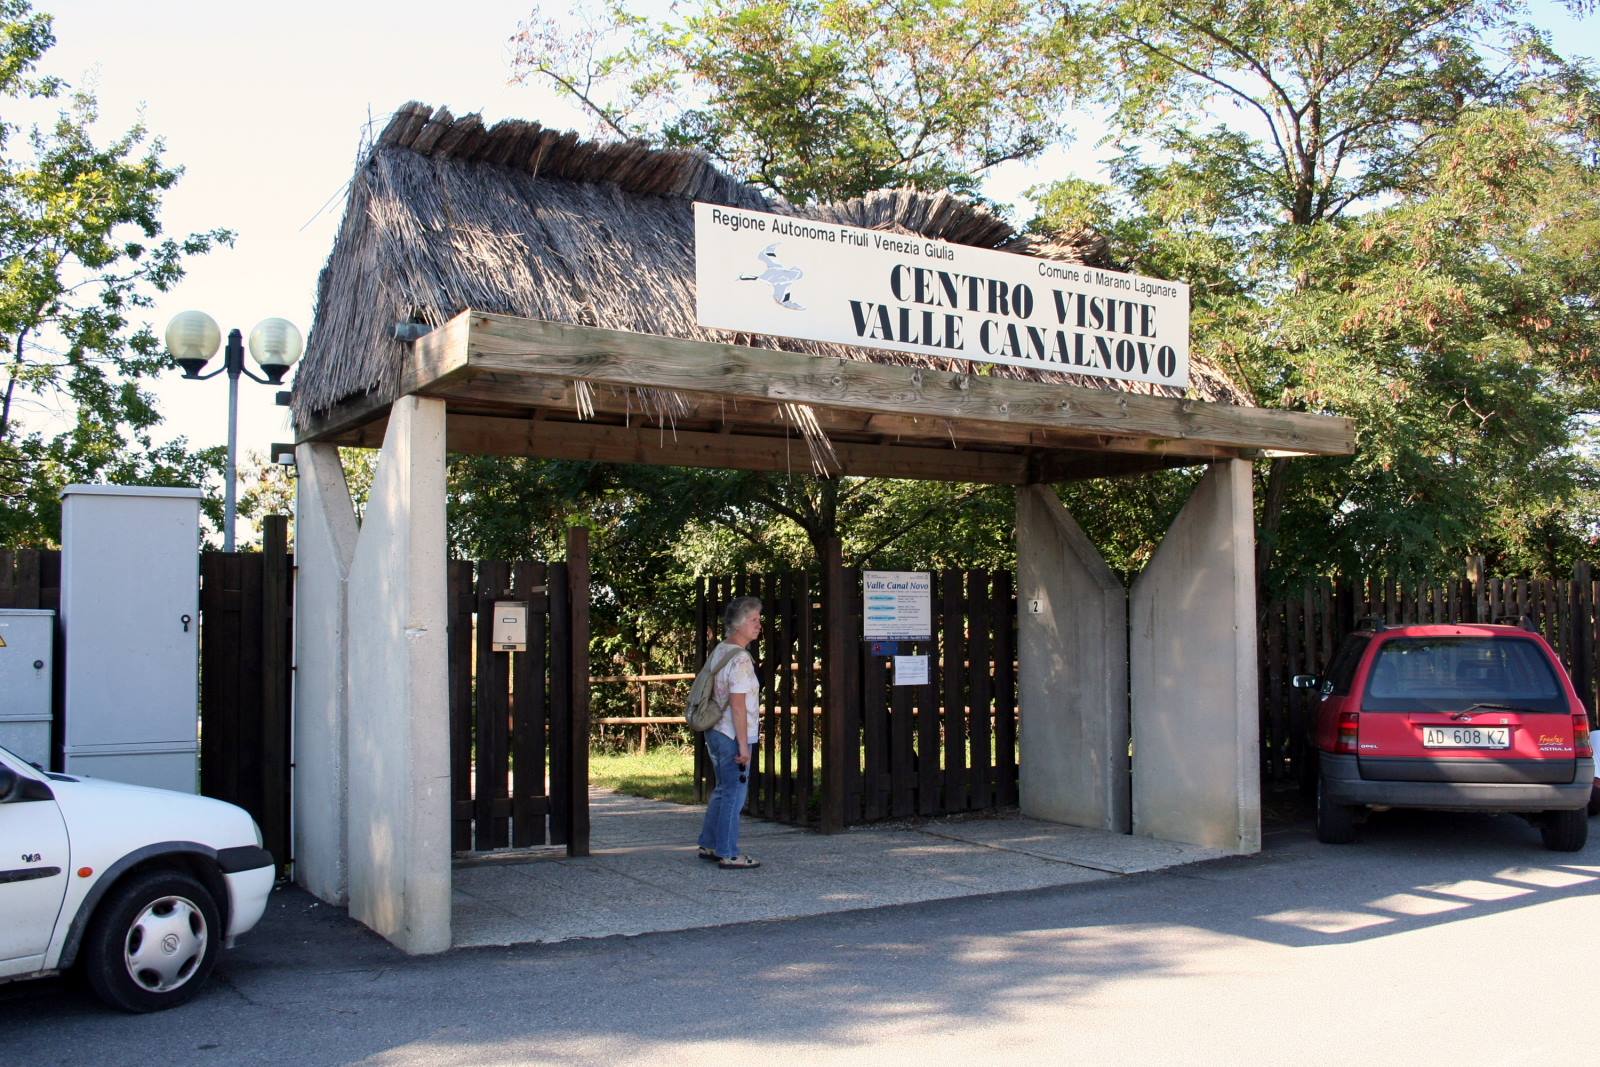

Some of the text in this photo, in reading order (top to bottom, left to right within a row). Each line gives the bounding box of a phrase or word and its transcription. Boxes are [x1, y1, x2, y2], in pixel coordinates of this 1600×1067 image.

[712, 208, 954, 261] Regione Autonoma Friuli Venezia Giulia
[1038, 262, 1177, 298] Comune di Marano Lagunare
[890, 263, 1157, 338] CENTRO VISITE
[848, 299, 964, 350] VALLE
[866, 581, 929, 590] Valle Canal Novo
[1033, 600, 1038, 612] 2
[1427, 729, 1505, 745] AD 608 KZ
